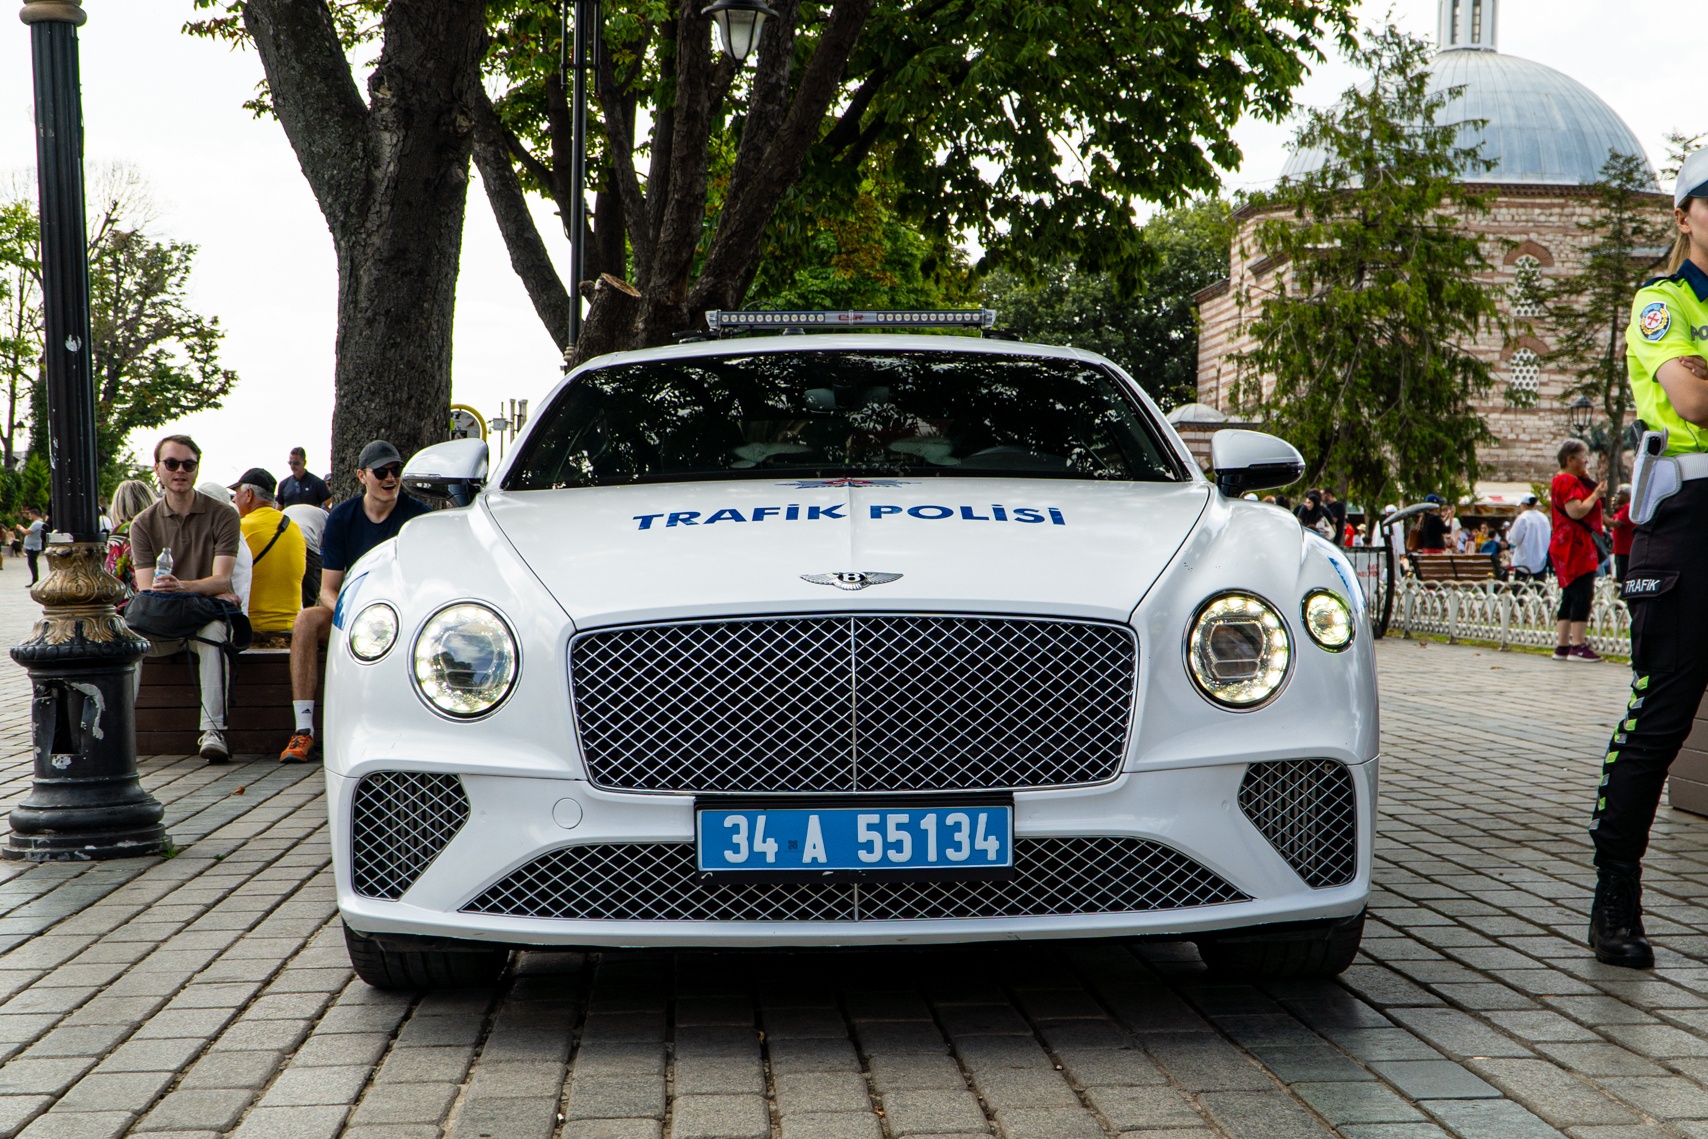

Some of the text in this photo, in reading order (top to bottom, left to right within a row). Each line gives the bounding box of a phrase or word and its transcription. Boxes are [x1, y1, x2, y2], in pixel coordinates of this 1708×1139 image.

[632, 502, 1066, 531] TRAFİK POLİSİ
[1625, 579, 1661, 594] TRAFİK
[723, 812, 1000, 864] 34 A 55134
